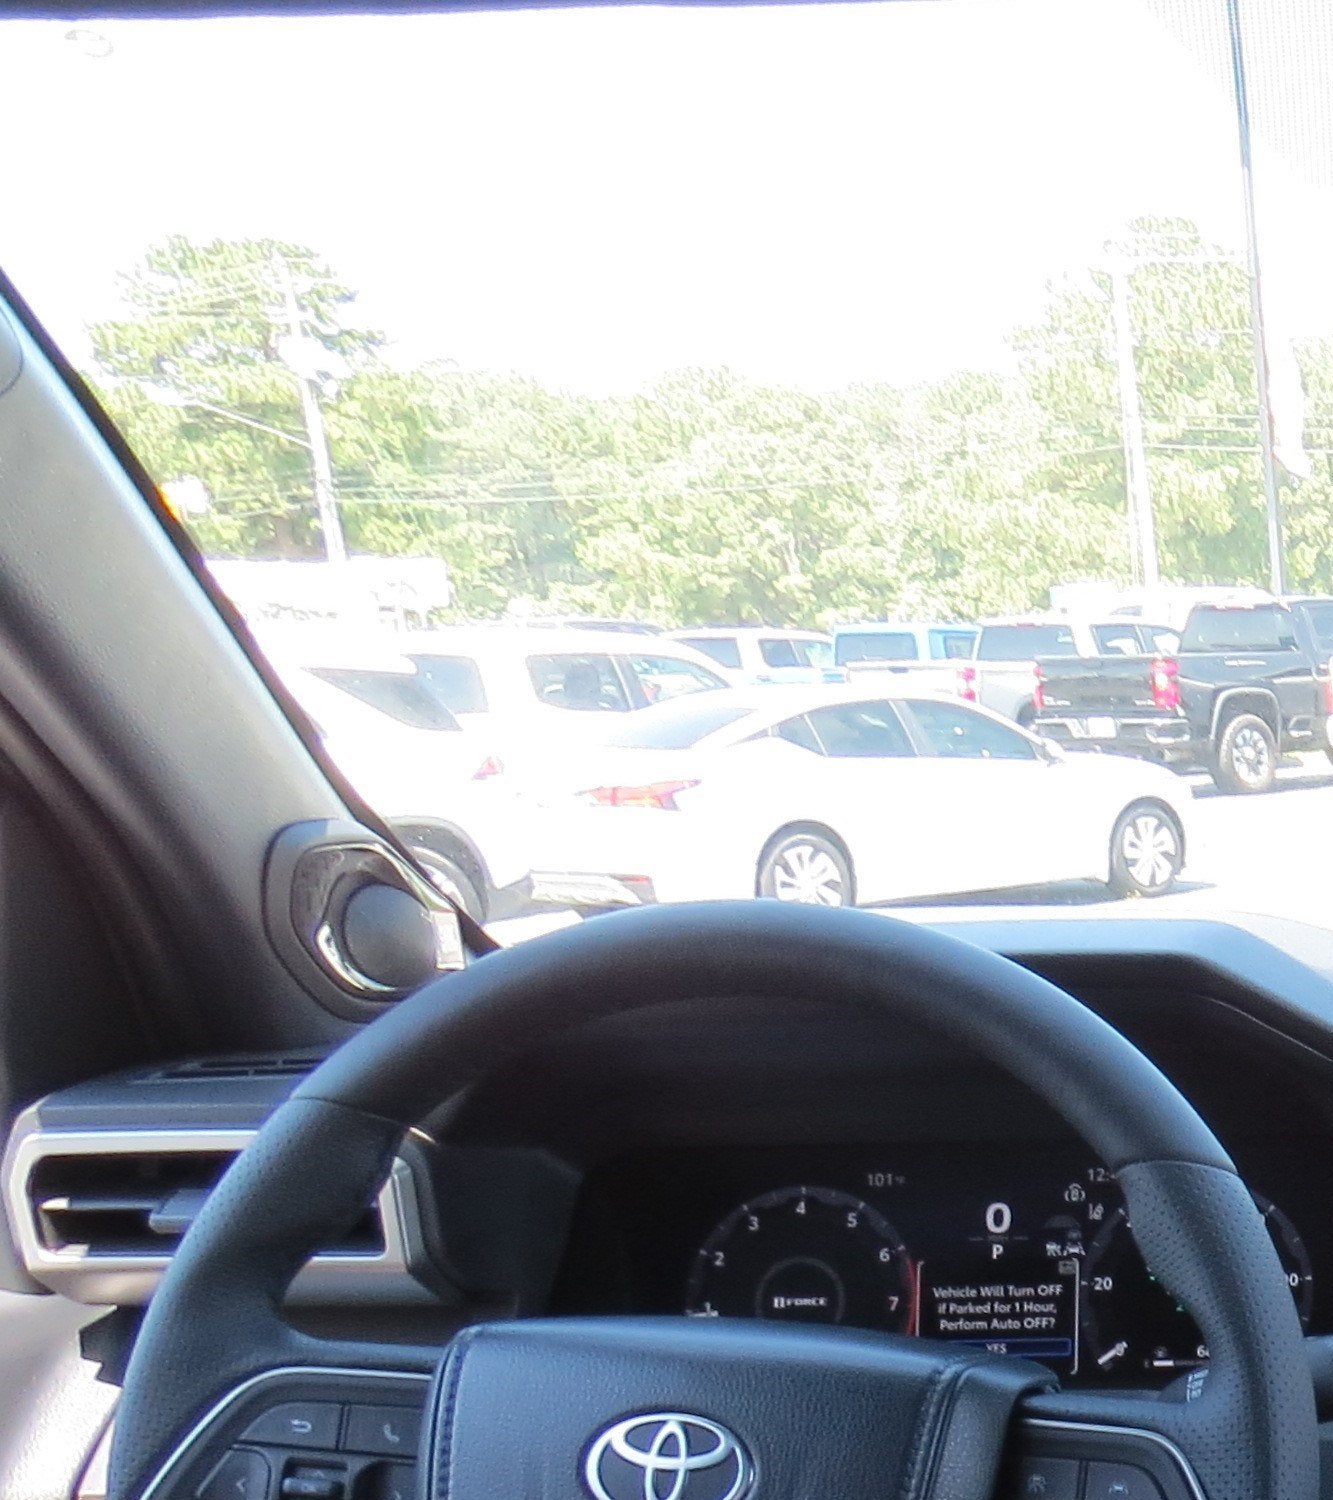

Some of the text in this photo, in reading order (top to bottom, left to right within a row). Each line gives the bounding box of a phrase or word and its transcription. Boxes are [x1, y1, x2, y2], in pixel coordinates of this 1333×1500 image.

[796, 1201, 806, 1215] 4
[749, 1216, 760, 1232] 3
[847, 1212, 858, 1228] 5
[985, 1203, 1012, 1234] 0
[713, 1251, 725, 1266] 2
[878, 1248, 890, 1262] 6
[991, 1245, 1005, 1260] P
[932, 1284, 1064, 1300] Vehicle Will Turn OFF
[888, 1296, 900, 1311] 7
[949, 1302, 990, 1315] Parked
[994, 1301, 1012, 1313] for
[1014, 1301, 1020, 1312] 1
[940, 1317, 1056, 1331] Perform Auto OFF?
